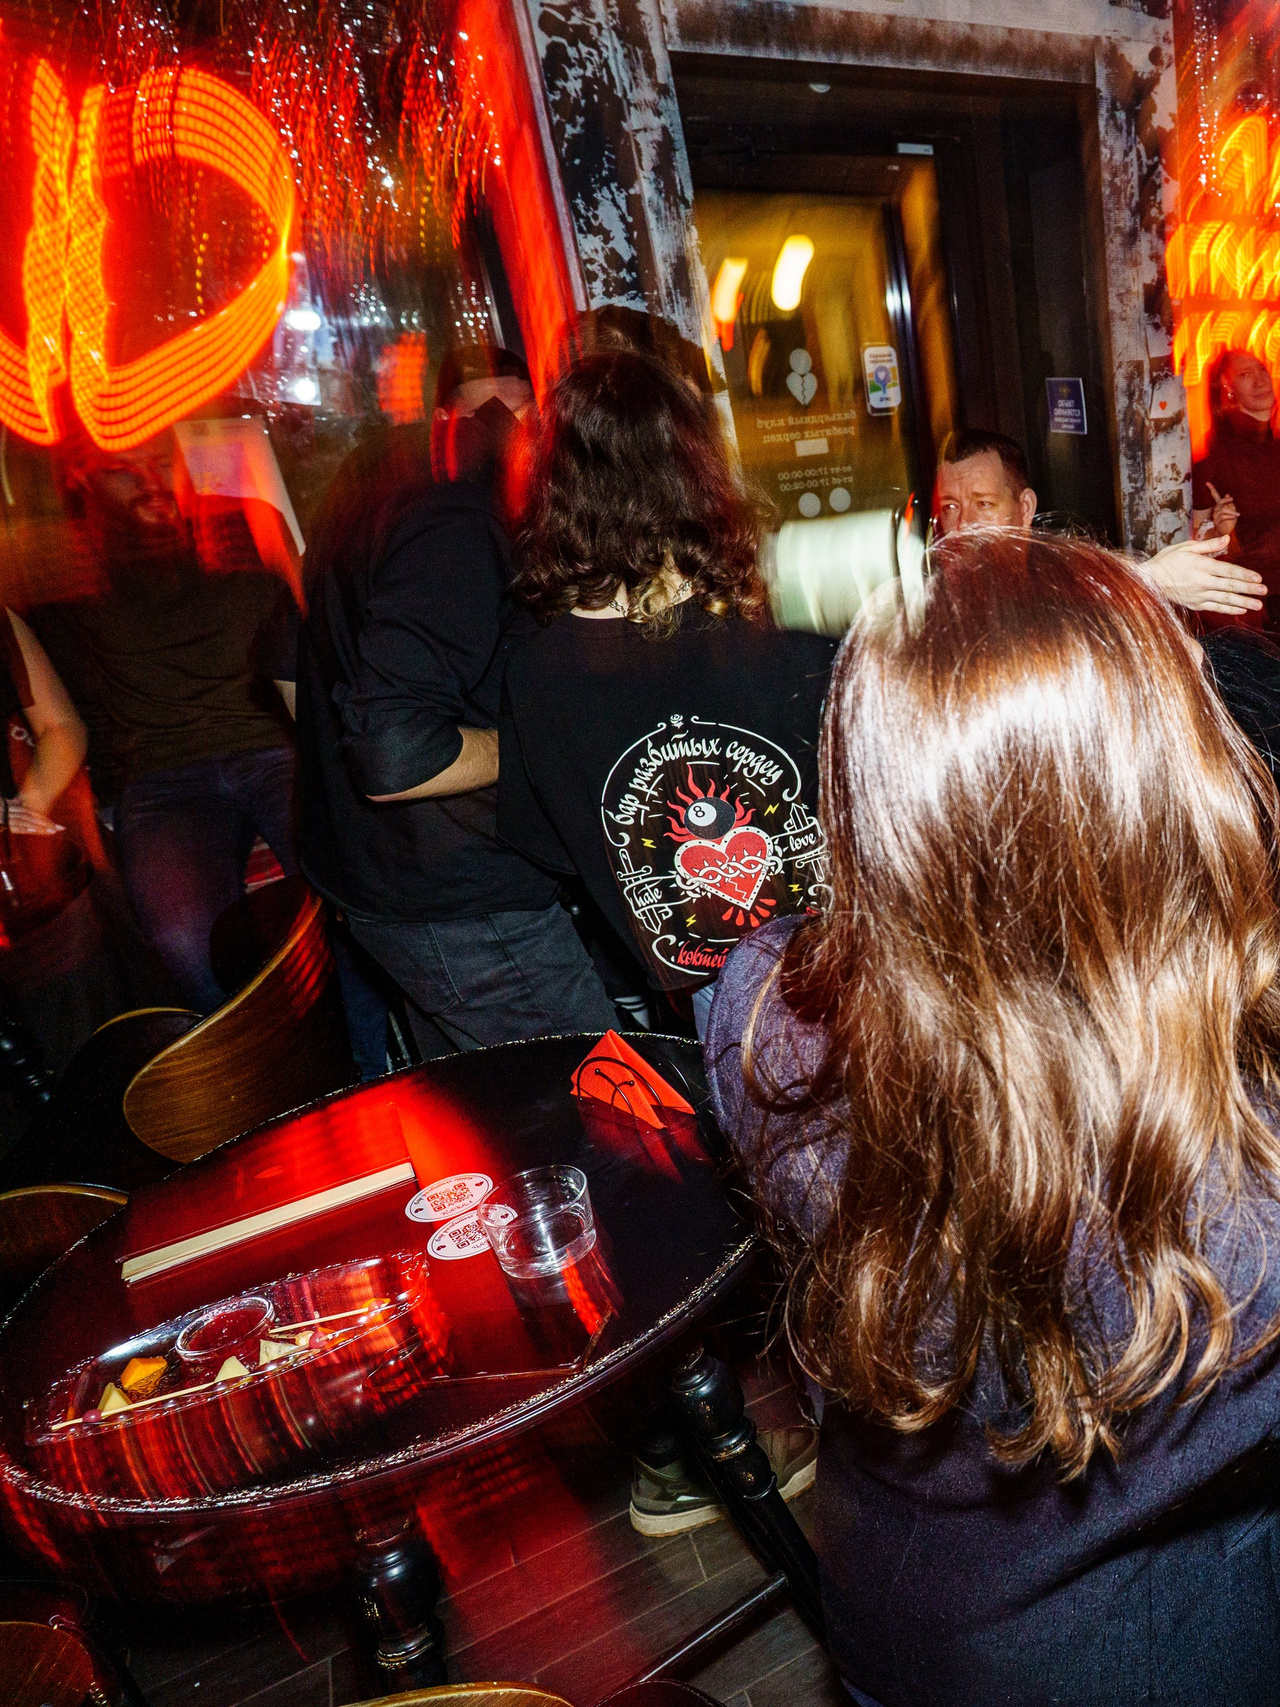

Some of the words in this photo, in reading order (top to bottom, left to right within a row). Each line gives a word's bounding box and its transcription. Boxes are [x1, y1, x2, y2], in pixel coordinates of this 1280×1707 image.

[605, 793, 650, 826] бар
[629, 730, 722, 795] разбитых
[725, 740, 784, 785] сердец
[692, 805, 706, 818] 8
[788, 832, 817, 852] love
[633, 884, 663, 907] hate
[677, 940, 729, 968] коктей
